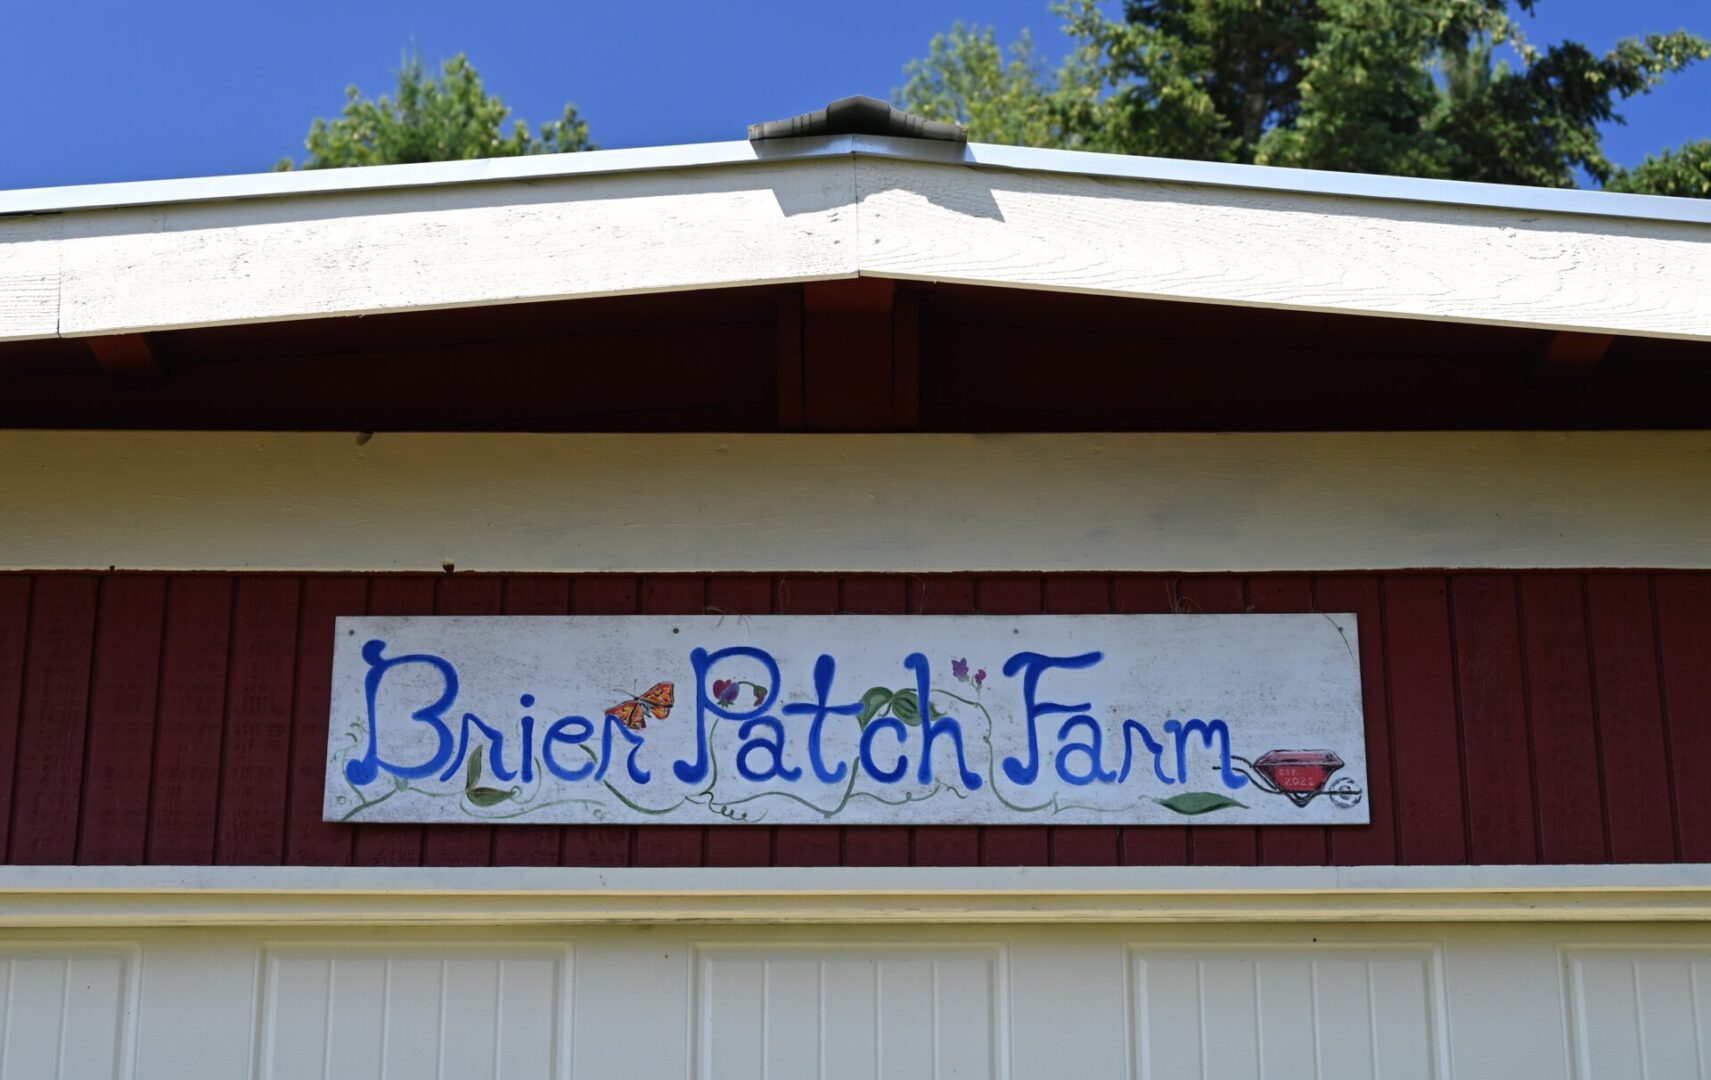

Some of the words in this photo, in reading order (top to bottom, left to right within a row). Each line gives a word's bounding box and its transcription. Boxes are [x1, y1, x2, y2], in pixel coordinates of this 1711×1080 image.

[345, 639, 651, 786] Brier
[672, 646, 983, 791] Patch
[1001, 650, 1249, 790] Farm
[1284, 776, 1315, 786] 2021
